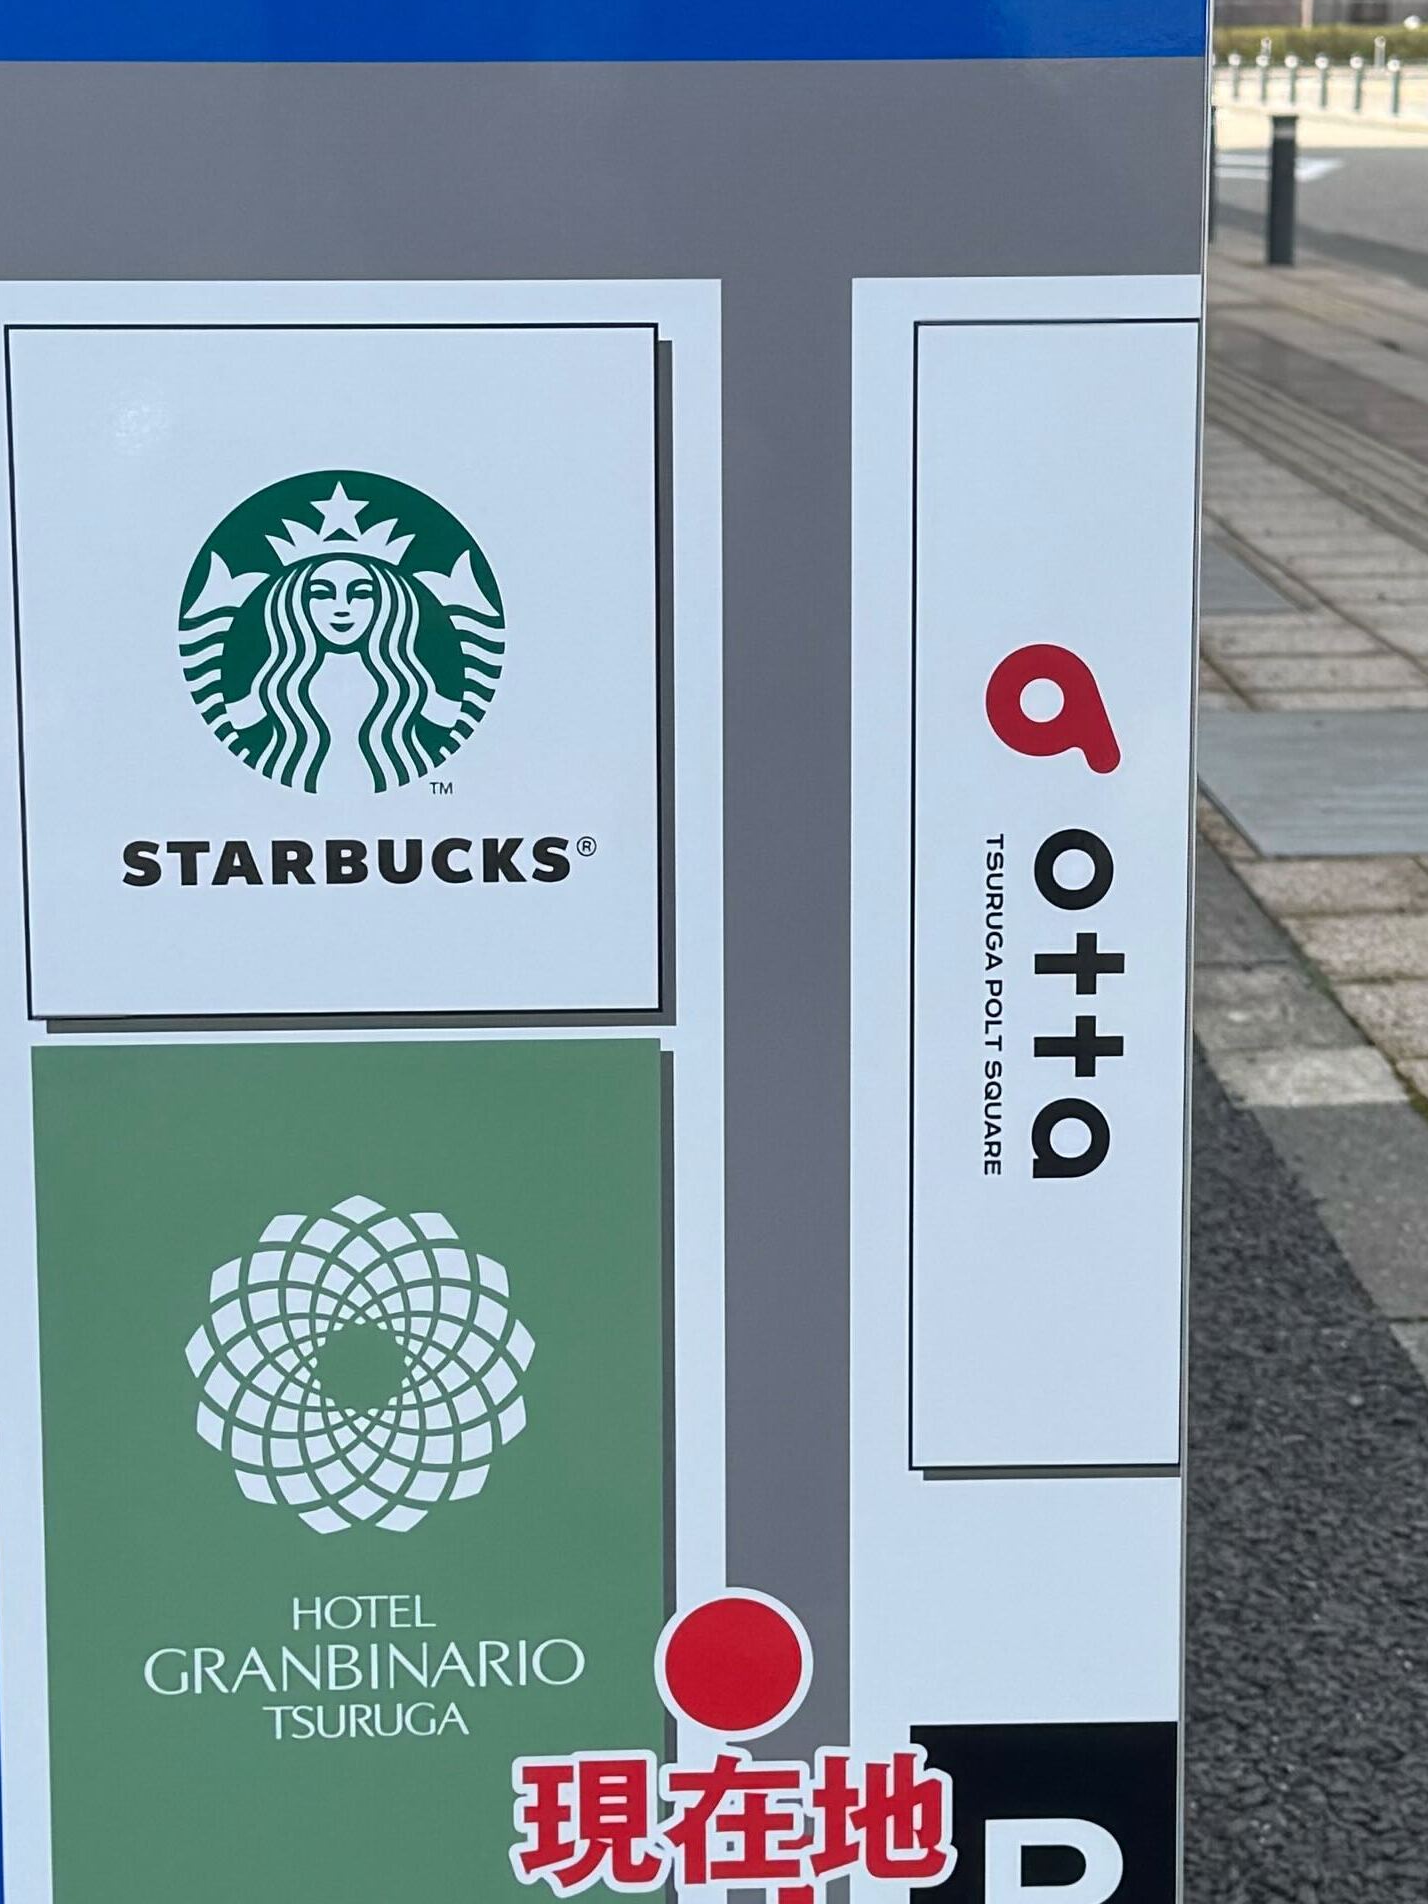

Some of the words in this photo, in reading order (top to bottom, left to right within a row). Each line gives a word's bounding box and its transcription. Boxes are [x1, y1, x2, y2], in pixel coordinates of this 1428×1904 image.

[429, 781, 454, 795] TM
[984, 832, 1005, 972] TSURUGA
[983, 978, 1004, 1053] POLT
[1030, 827, 1126, 1180] otta
[982, 1059, 1004, 1177] SQUARE
[292, 1594, 437, 1632] HOTEL
[143, 1638, 585, 1696] GRANBINARIO
[262, 1702, 470, 1740] TSURUGA
[517, 1753, 953, 1890] 現在地
